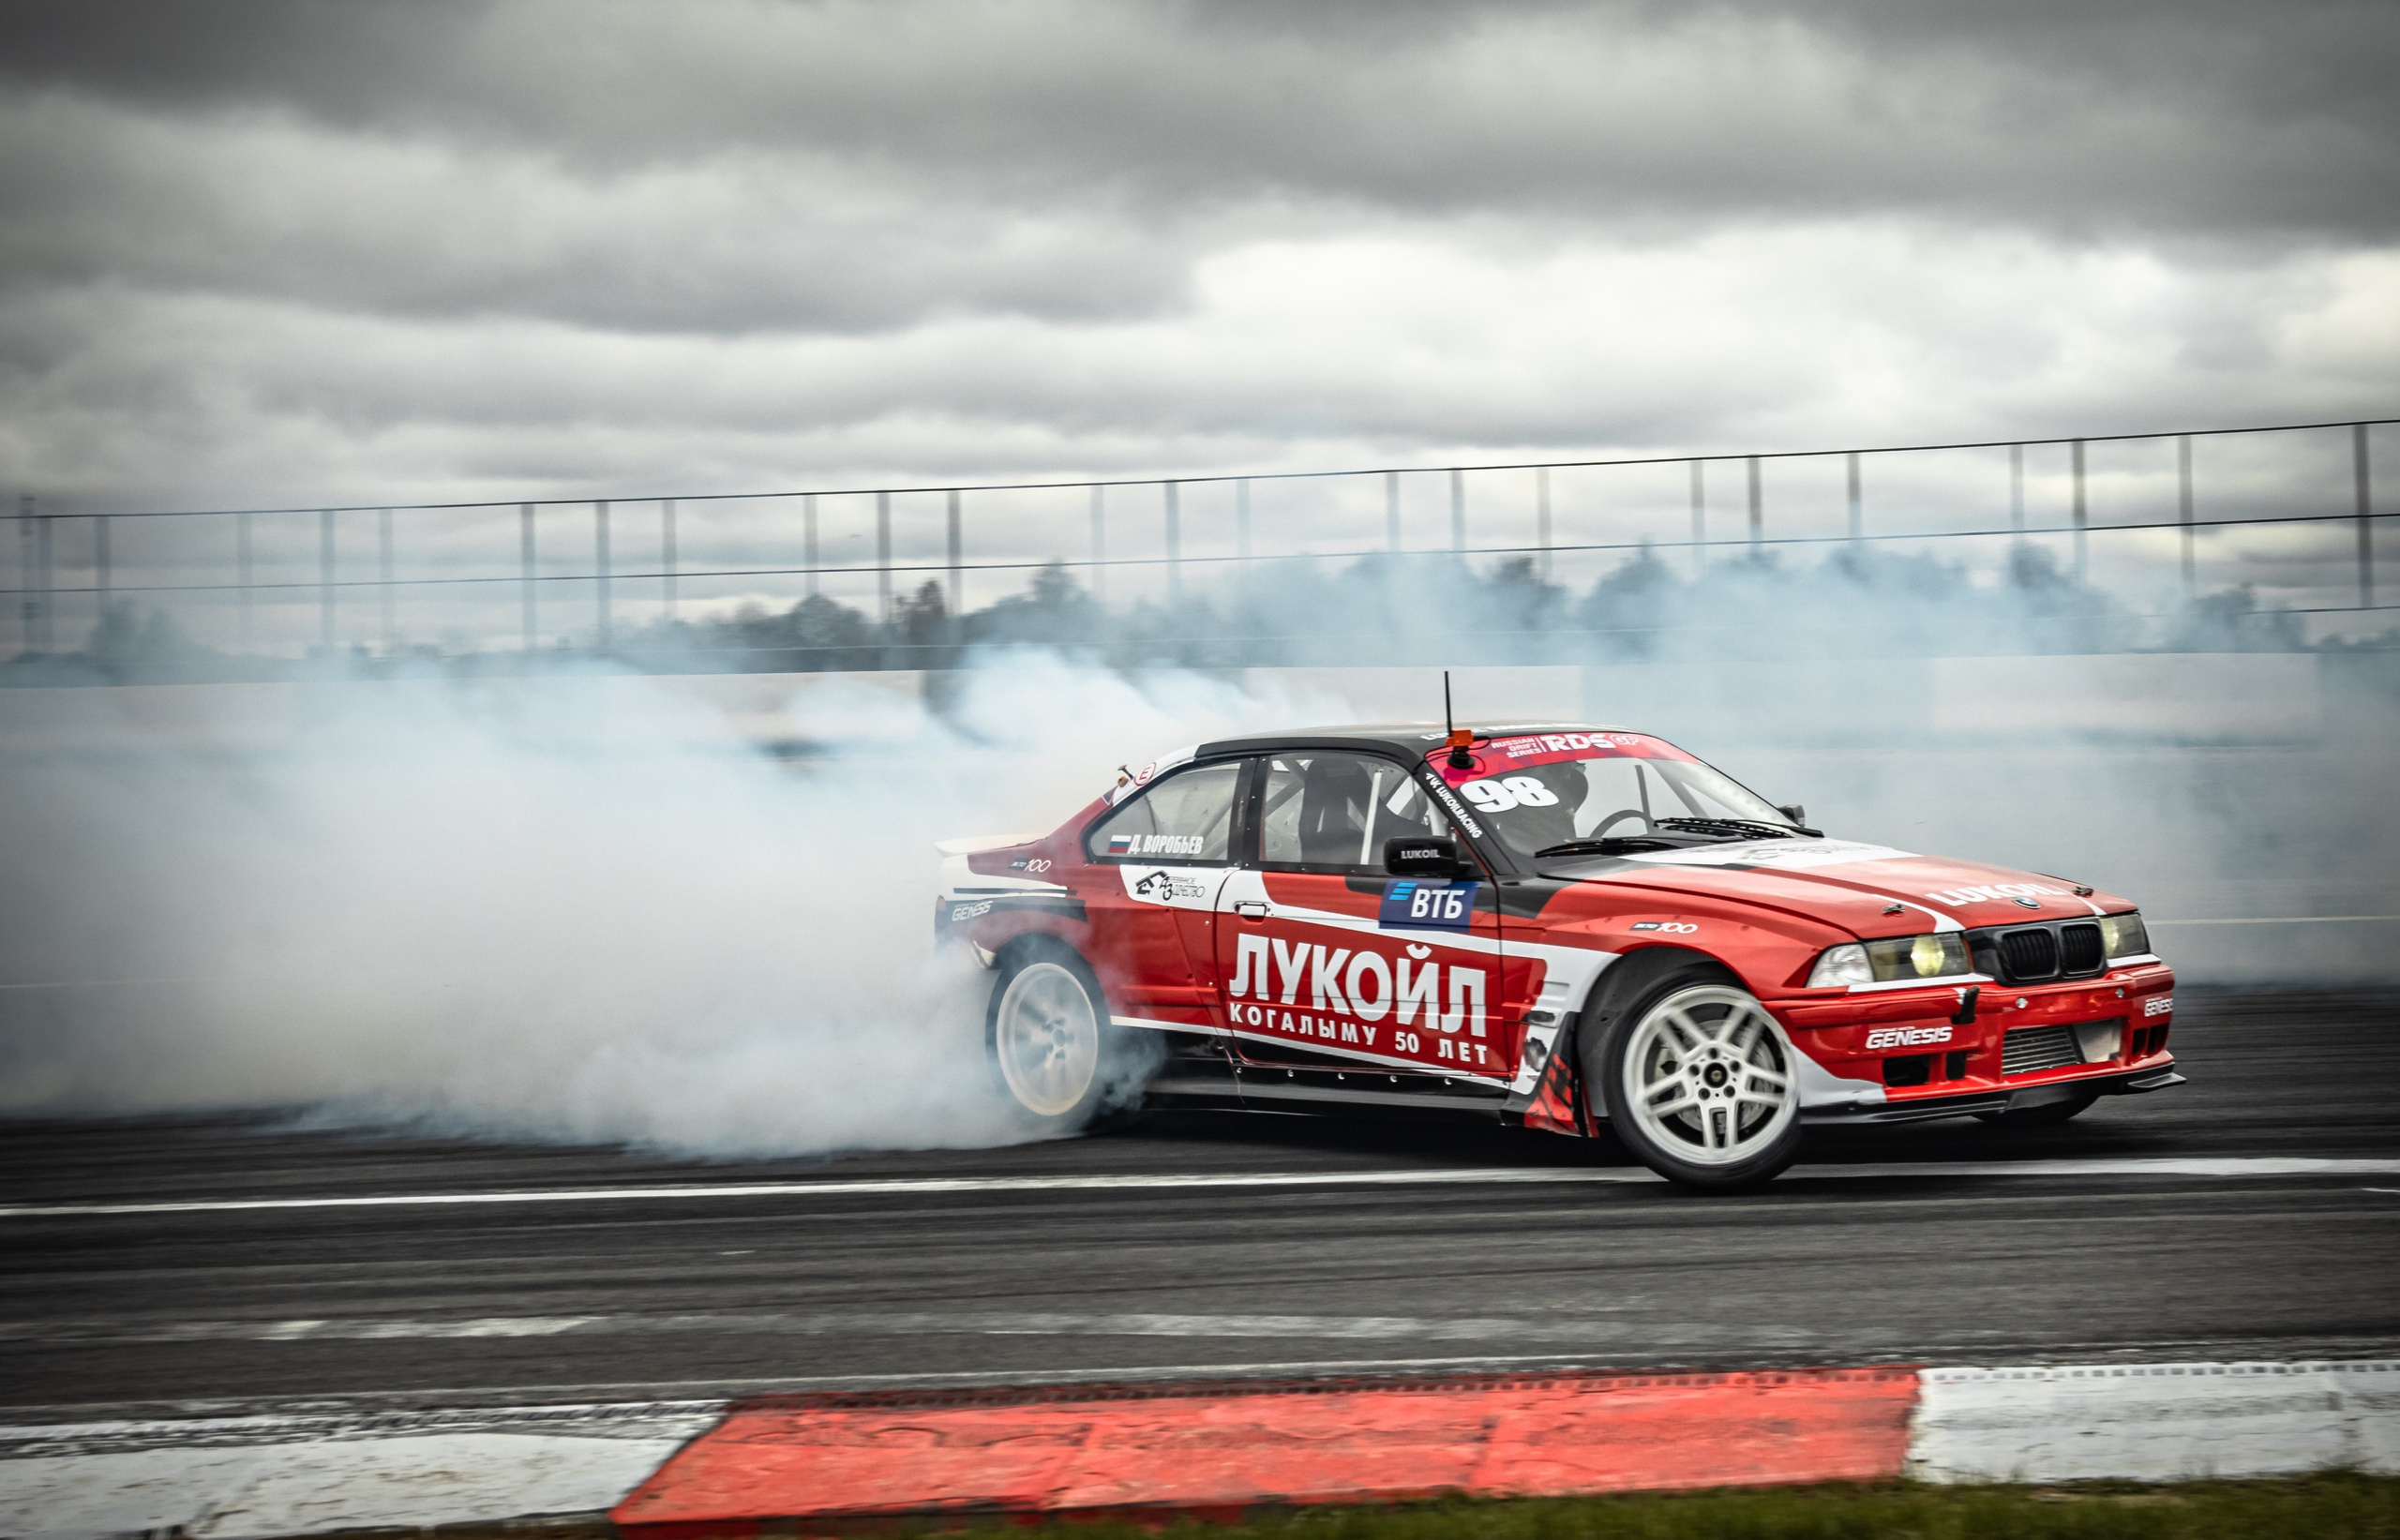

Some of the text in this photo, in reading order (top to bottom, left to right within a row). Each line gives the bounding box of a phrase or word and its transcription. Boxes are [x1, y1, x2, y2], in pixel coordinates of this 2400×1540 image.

[1491, 738, 1535, 749] RUSSIAN
[1506, 747, 1542, 758] SERIES
[1509, 742, 1538, 752] DRIFT
[1539, 734, 1640, 752] RDS GP
[1460, 776, 1559, 814] 98
[1435, 786, 1483, 839] LUKOILRACING
[1142, 834, 1204, 855] ВОРОБЬЕВ
[1401, 849, 1440, 860] LUKOIL
[1024, 859, 1052, 873] 100
[1411, 889, 1466, 920] ВТБ
[1925, 883, 2068, 906] LUKOIL
[1656, 922, 1698, 934] 100
[1228, 933, 1487, 1038] ЛУКОЙЛ
[1230, 1003, 1488, 1065] КОГАЛЫМУ 50 ЛЕТ
[1865, 1026, 1953, 1049] GENESIS
